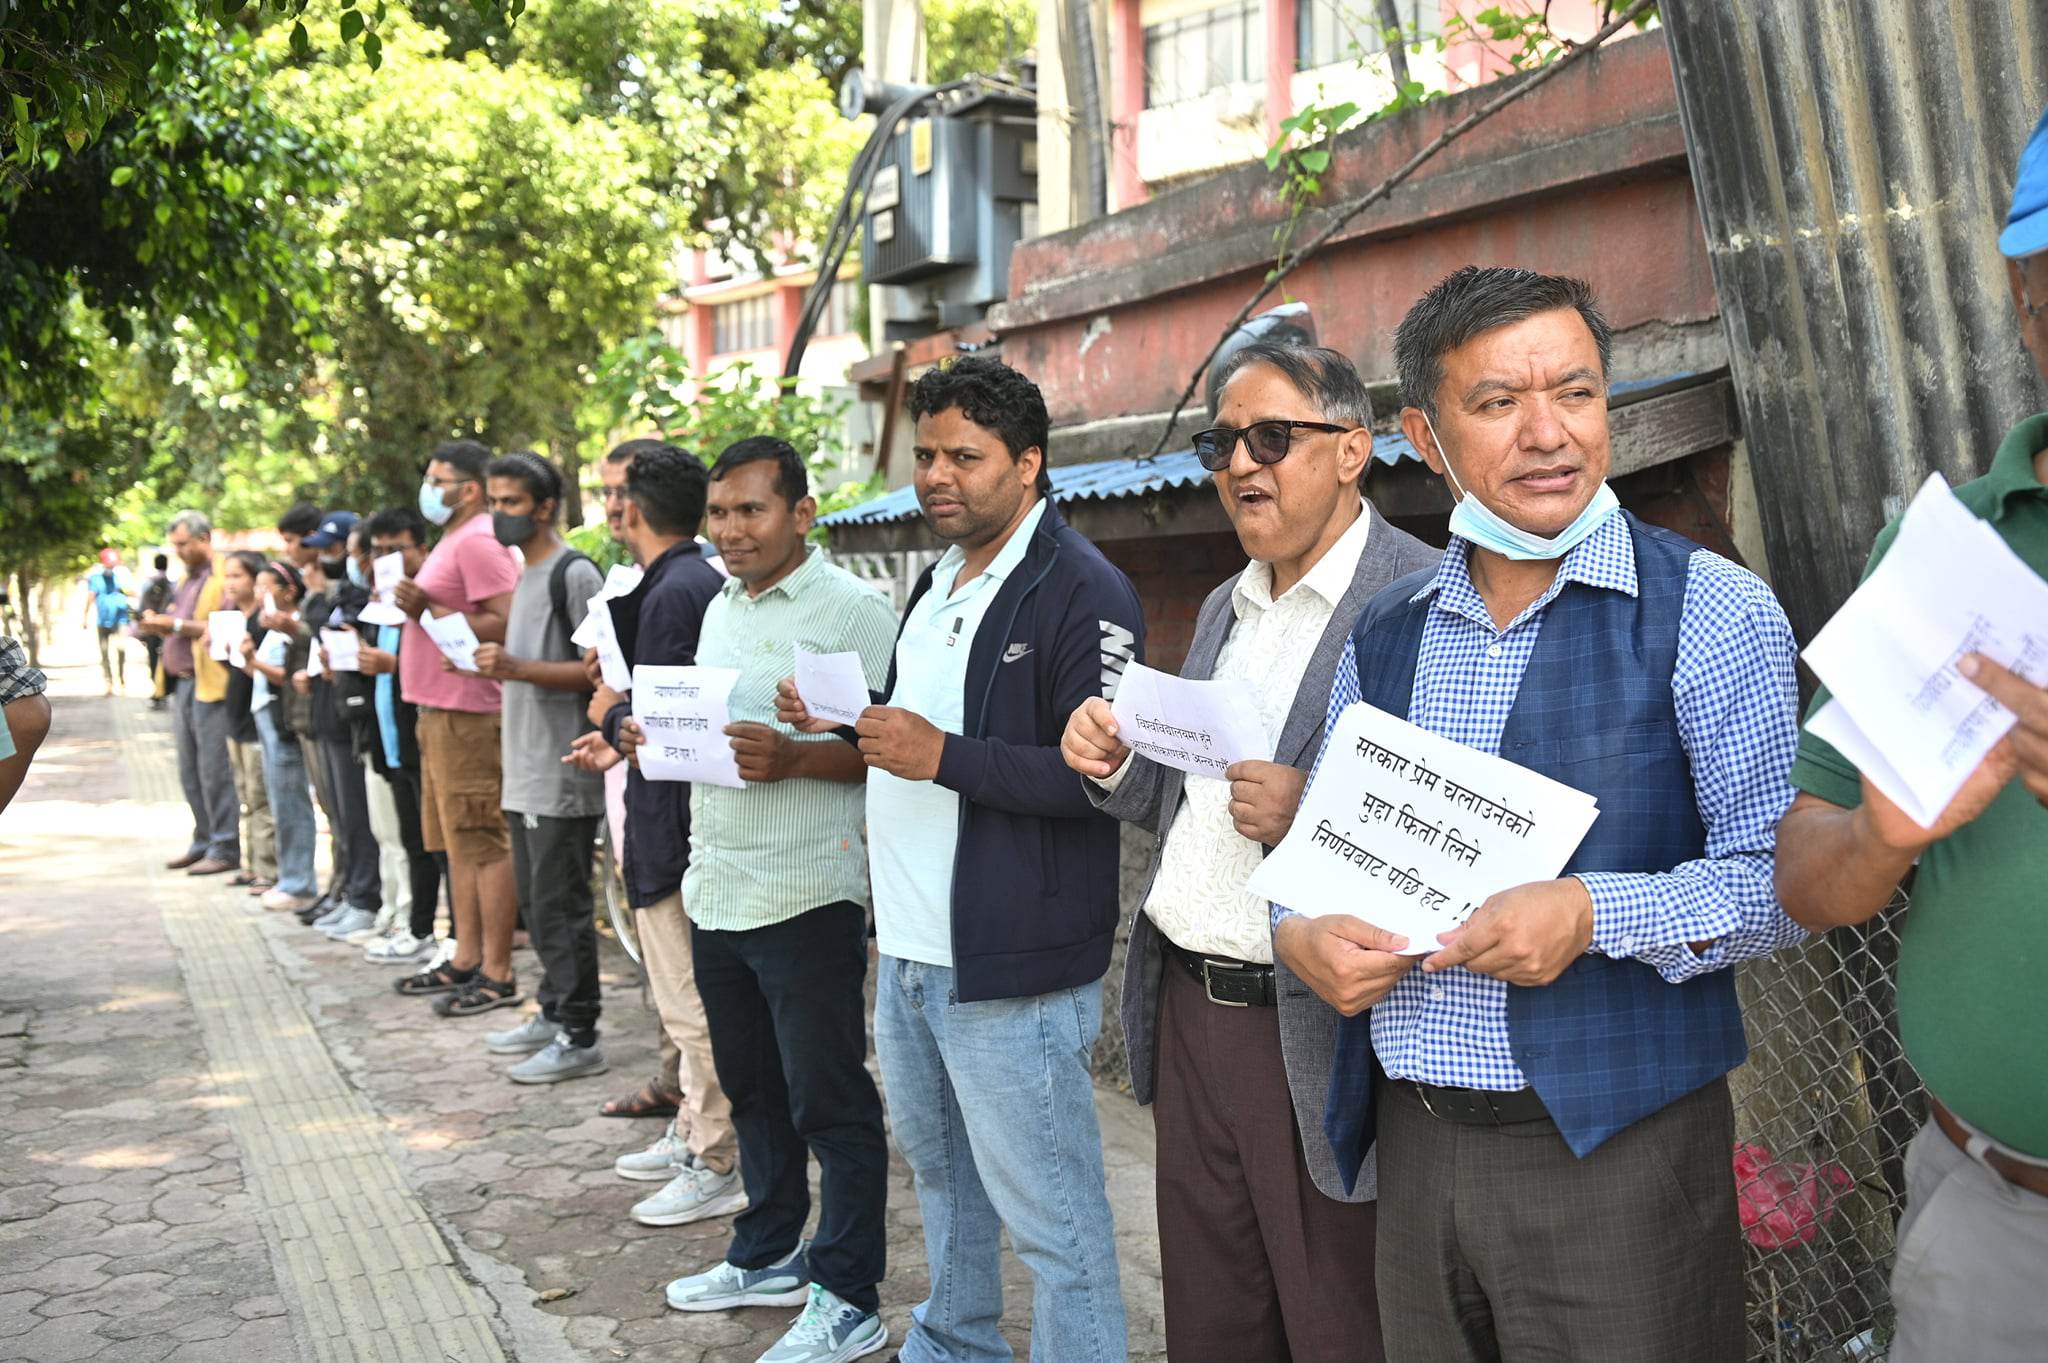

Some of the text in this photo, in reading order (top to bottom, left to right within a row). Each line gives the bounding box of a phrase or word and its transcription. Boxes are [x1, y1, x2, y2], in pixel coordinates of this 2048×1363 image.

[1355, 736, 1536, 839] सरकार प्रेम चलाउनेको
[1358, 791, 1482, 868] मुद्दा फिर्ता लिने
[1311, 819, 1388, 878] निर्णयबाट
[1386, 867, 1424, 897] पछि
[1424, 886, 1451, 912] हट
